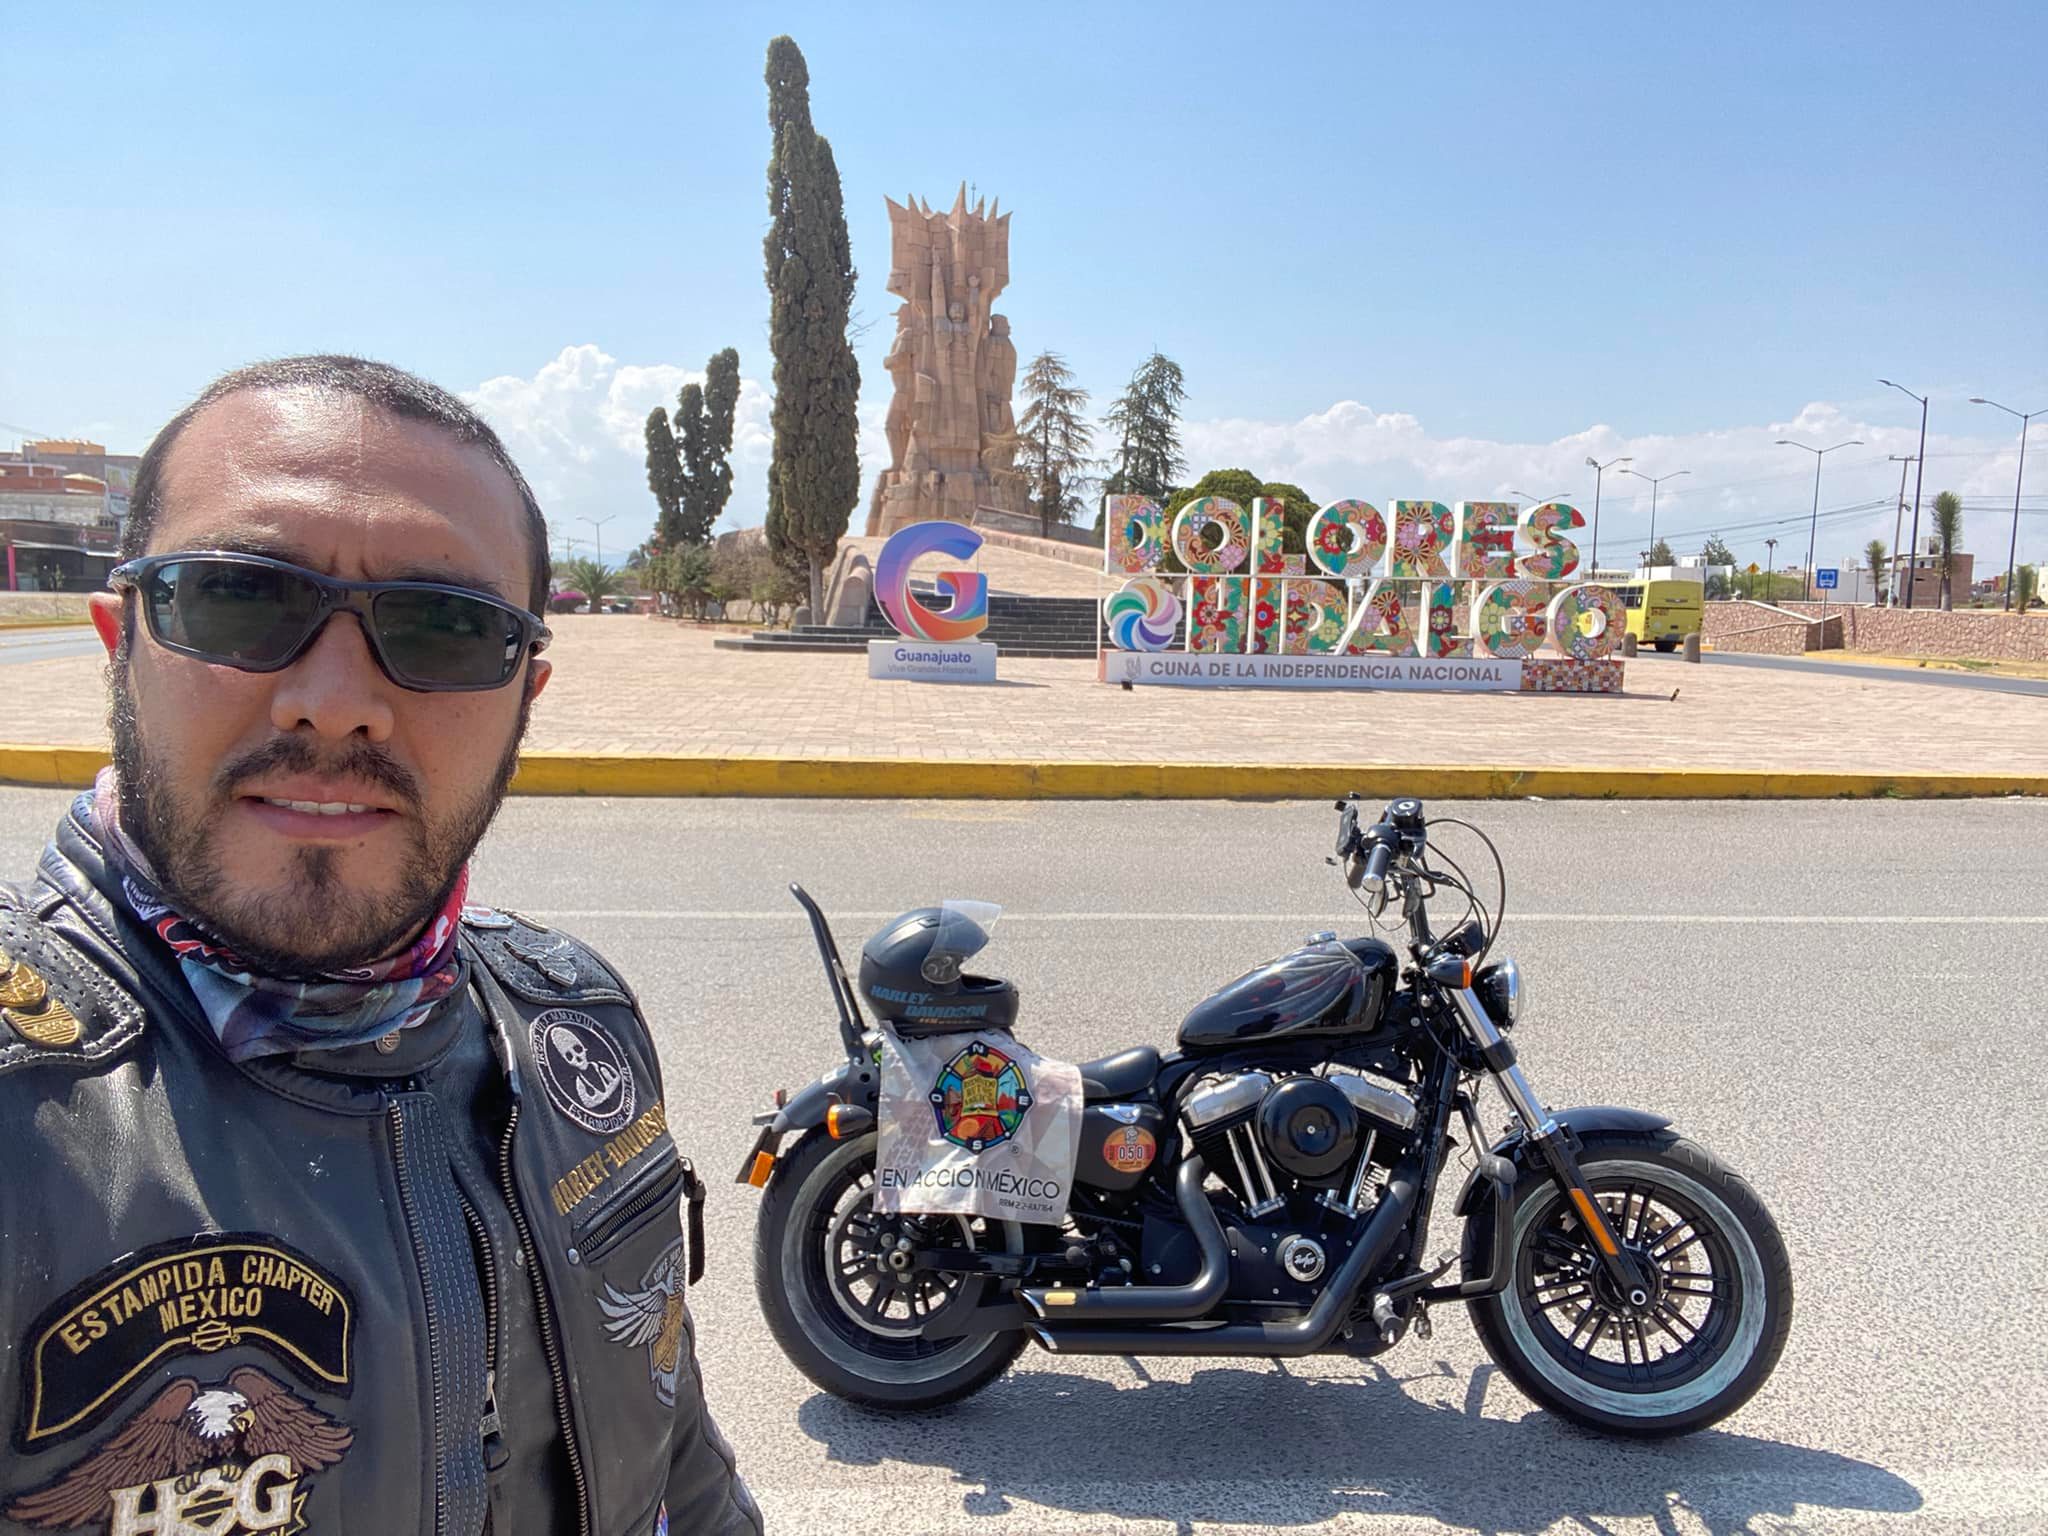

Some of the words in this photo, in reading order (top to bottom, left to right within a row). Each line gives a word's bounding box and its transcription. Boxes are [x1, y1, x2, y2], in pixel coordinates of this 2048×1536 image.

[1104, 494, 1586, 580] DOLORES
[1185, 575, 1627, 660] HIDALGO
[894, 648, 972, 665] Guanajuato
[1150, 661, 1202, 676] CUNA
[1208, 662, 1231, 677] DE
[1236, 663, 1257, 678] LA
[1264, 663, 1403, 680] INDEPENDENCIA
[1409, 665, 1502, 682] NACIONAL
[972, 1044, 984, 1054] N
[1018, 1096, 1029, 1106] E
[568, 1103, 625, 1129] ESTAMPIDA
[972, 1141, 983, 1150] S
[1119, 1146, 1143, 1160] 050
[881, 1168, 908, 1188] EN
[912, 1164, 986, 1190] ACCIÓN
[987, 1169, 1060, 1199] MÉXICO
[59, 1256, 226, 1355] ESTAMPIDA
[242, 1254, 335, 1316] CHAPTER
[159, 1287, 263, 1334] MEXICO
